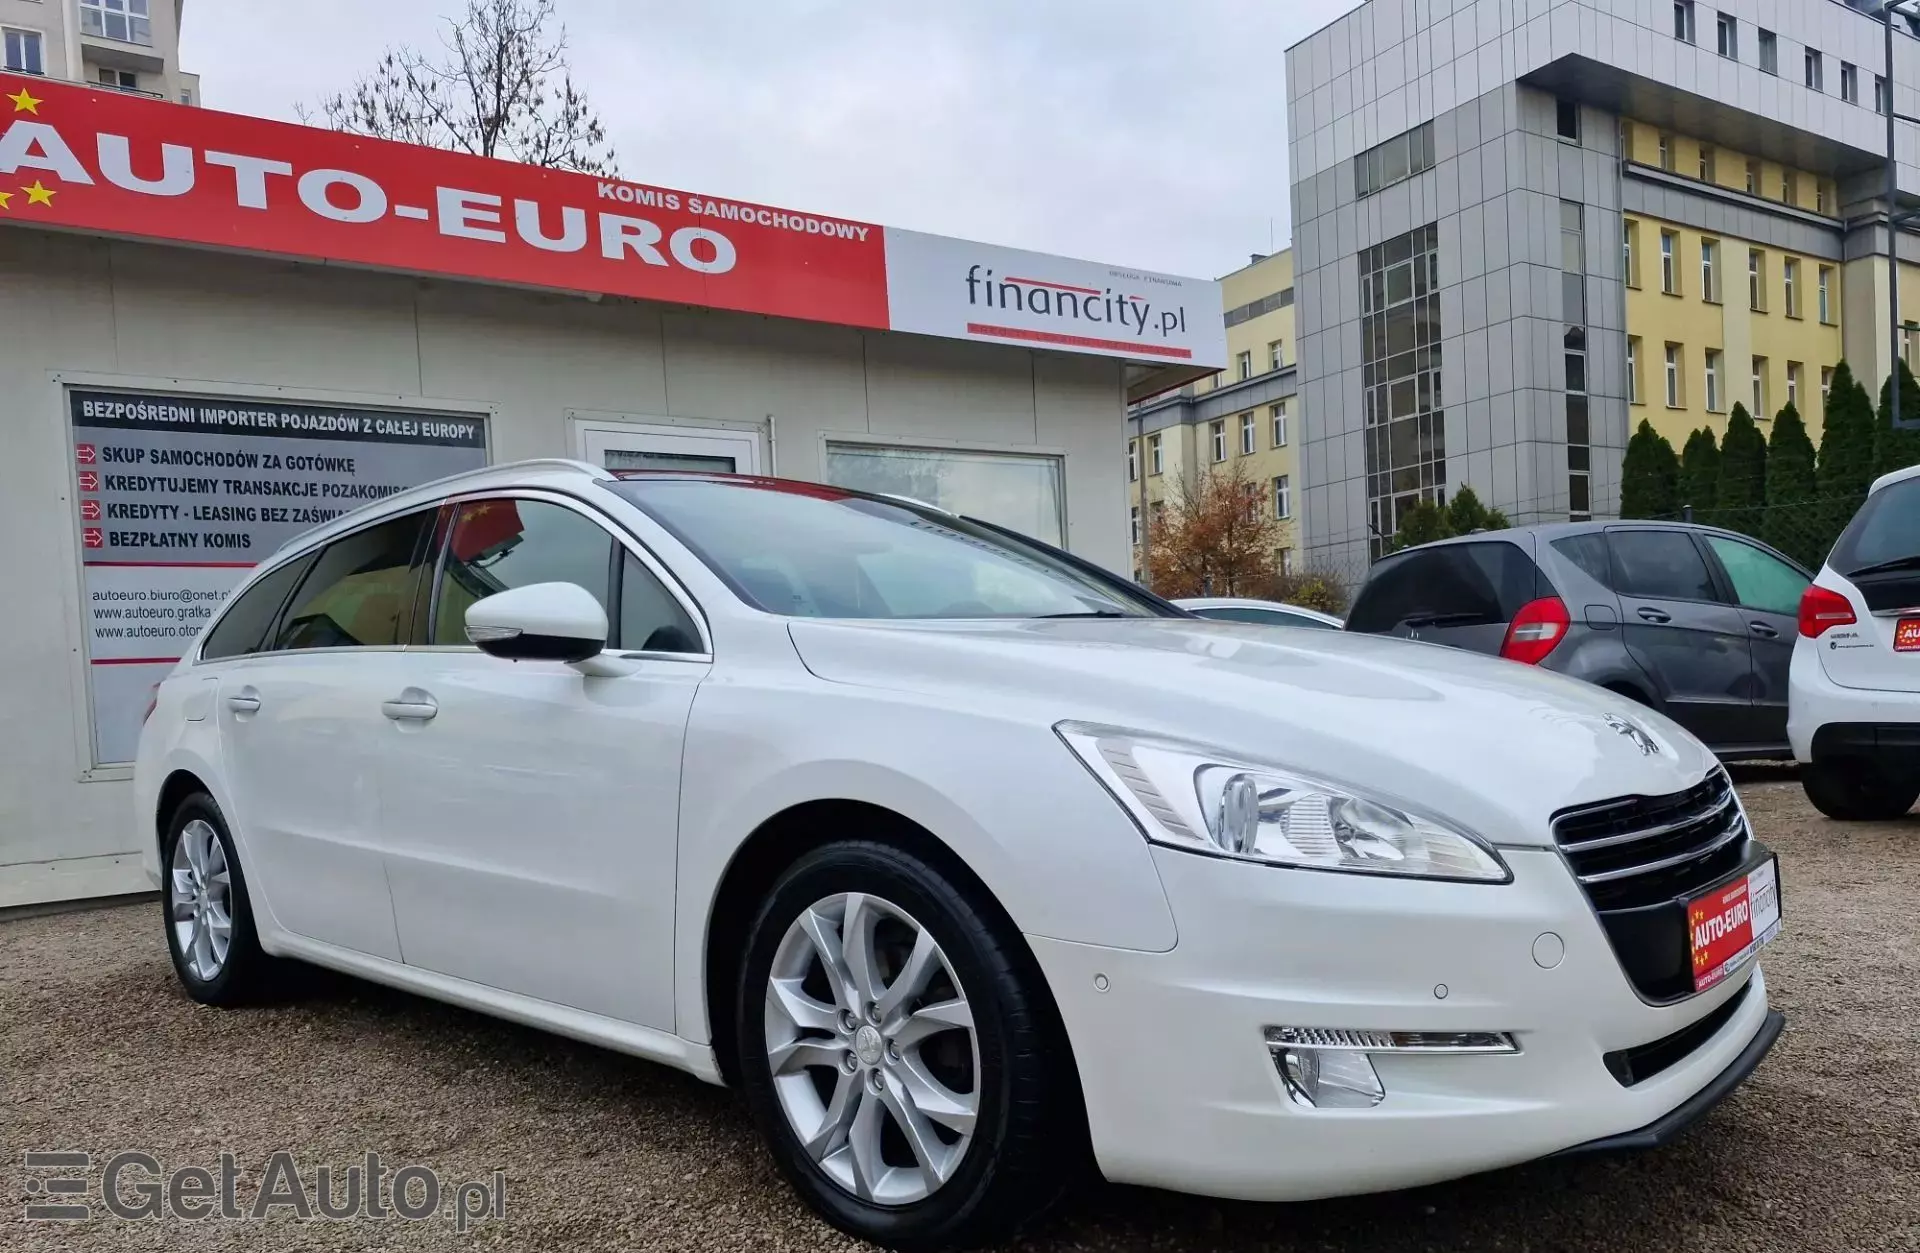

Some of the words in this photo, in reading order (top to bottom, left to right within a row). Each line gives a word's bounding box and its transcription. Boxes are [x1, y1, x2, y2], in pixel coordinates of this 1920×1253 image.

[0, 119, 737, 274] AUTO-EURO
[598, 181, 681, 210] KOMIS
[688, 197, 869, 242] SAMOCHODOWY
[965, 264, 1187, 338] financity.pl
[83, 400, 195, 424] BEZPOŚREDNI
[200, 408, 278, 428] IMPORTER
[281, 412, 360, 433] POJAZDÓW
[363, 418, 373, 434] Z
[375, 418, 419, 437] CAŁEJ
[422, 422, 475, 440] EUROPY
[102, 446, 146, 464] SKUP
[150, 448, 259, 469] SAMOCHODÓW
[262, 454, 282, 470] ZA
[285, 453, 356, 477] GOTÓWKĘ
[105, 474, 219, 494] KREDYTUJEMY
[223, 479, 319, 498] TRANSAKCJE
[107, 503, 180, 520] KREDYTY
[193, 505, 257, 523] LEASING
[261, 507, 289, 523] BEZ
[292, 505, 351, 524] ZAŚWI
[109, 531, 199, 548] BEZPŁATNY
[203, 533, 251, 549] KOMIS
[92, 589, 232, 604] autoeuro.biuro@onet.p
[93, 605, 217, 622] www.autoeuro.gratka
[1694, 899, 1749, 951] AUTO-EURO
